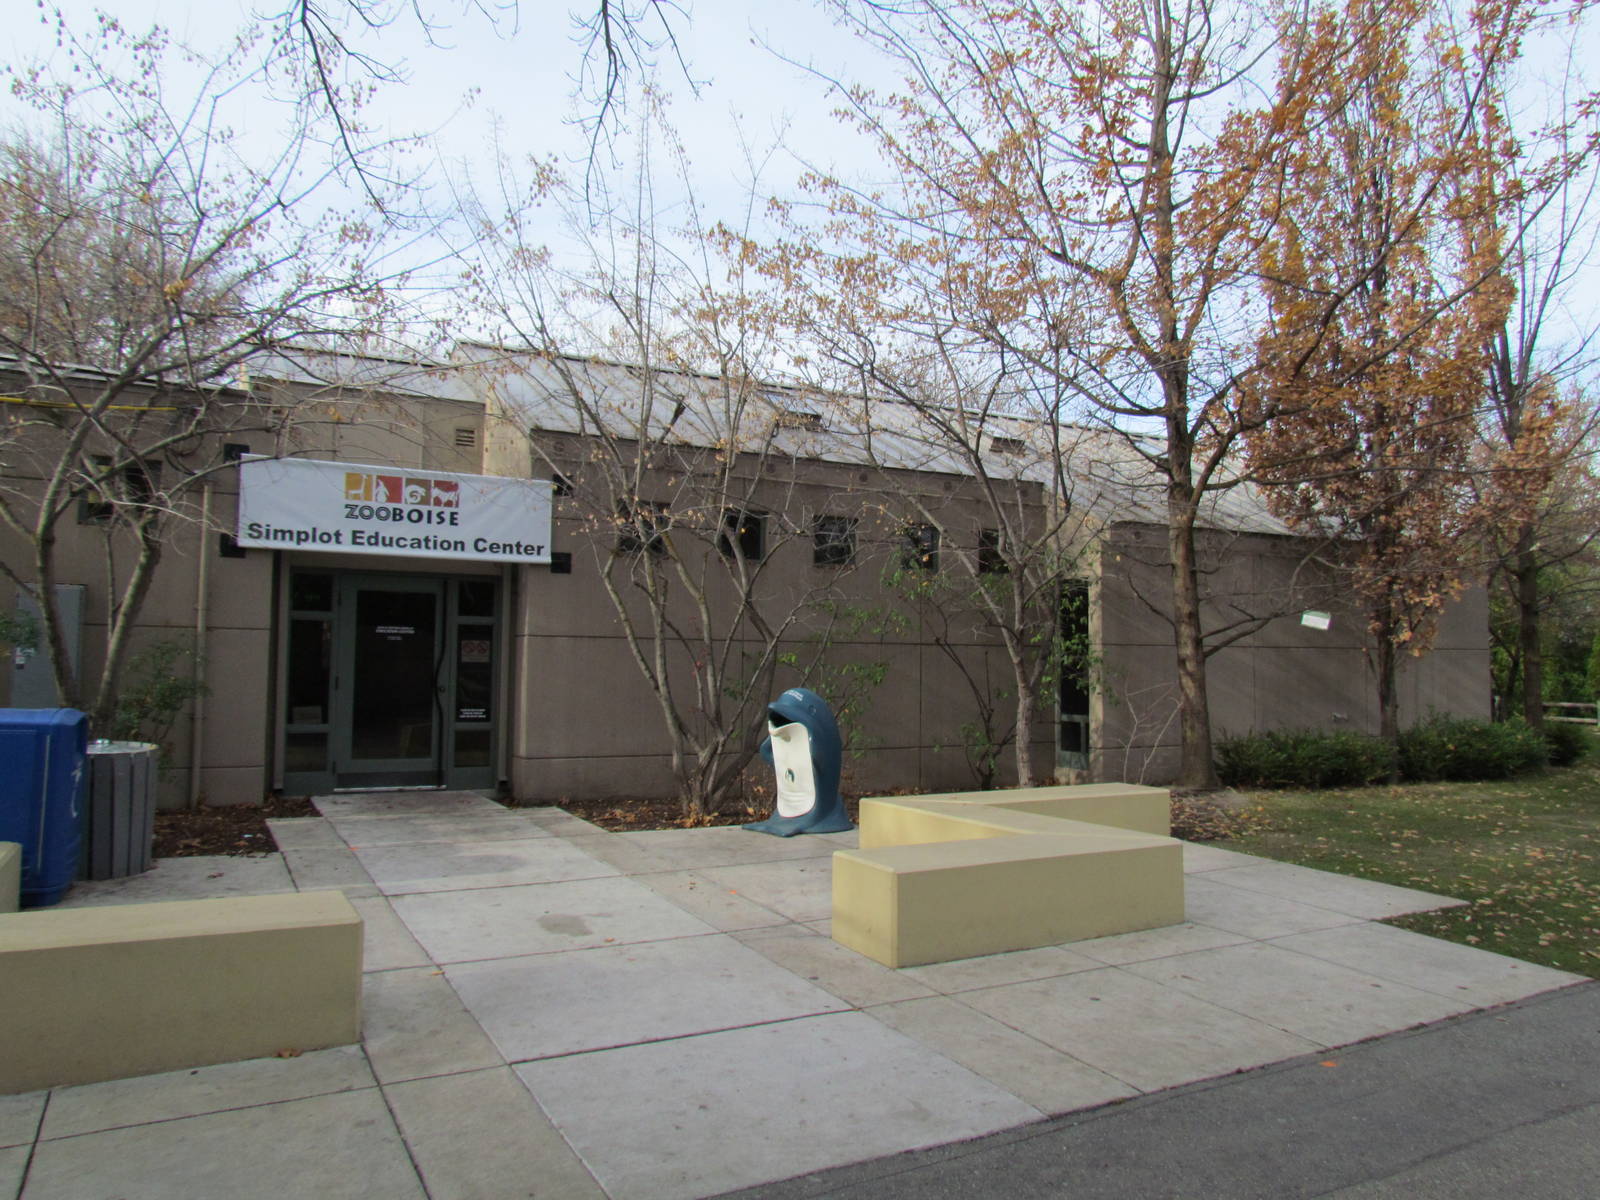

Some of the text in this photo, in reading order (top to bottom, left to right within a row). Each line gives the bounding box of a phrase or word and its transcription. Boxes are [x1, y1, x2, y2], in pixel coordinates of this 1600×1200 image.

[247, 522, 545, 556] Simplot Education Center
